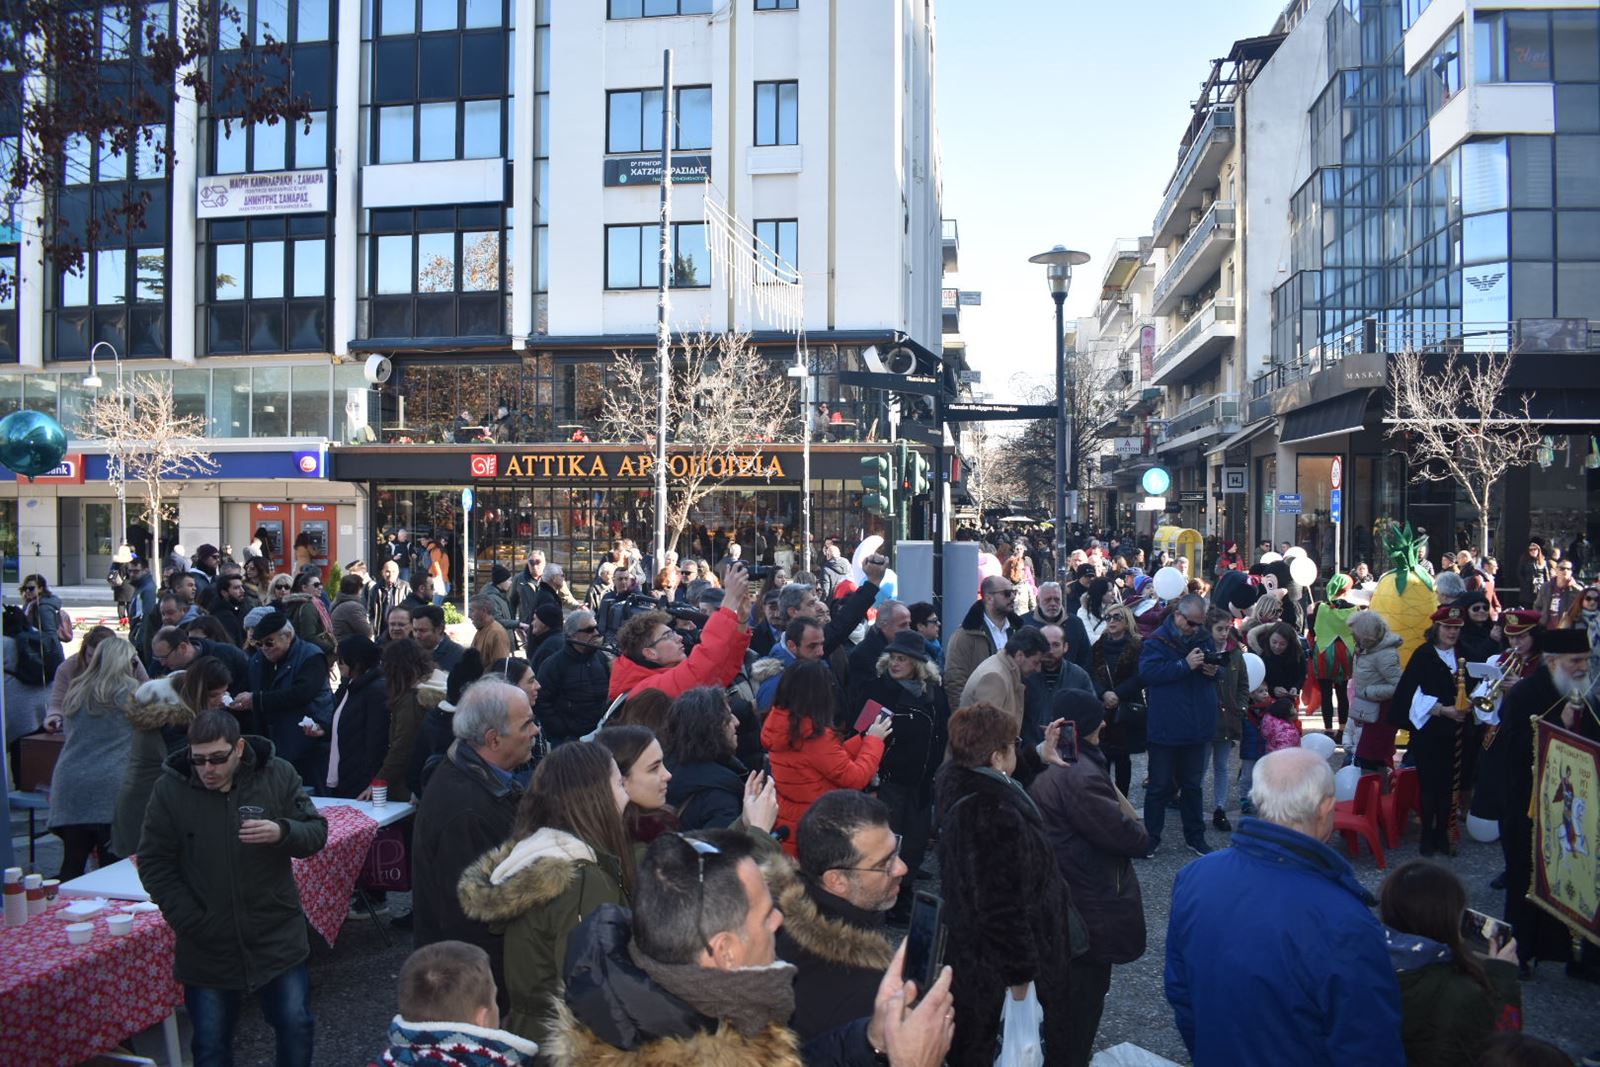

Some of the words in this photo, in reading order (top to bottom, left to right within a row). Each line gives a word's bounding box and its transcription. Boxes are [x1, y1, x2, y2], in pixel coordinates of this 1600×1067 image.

[244, 194, 277, 205] ΔΗΜΗΤΡΗΣ
[278, 192, 308, 204] ΣΑΜΑΡΑΣ
[1346, 371, 1382, 379] MASKA
[505, 454, 608, 477] ΑΤΤΙΚΑ
[617, 454, 786, 478] ΑΡΟΠΟΙΕΙΑ
